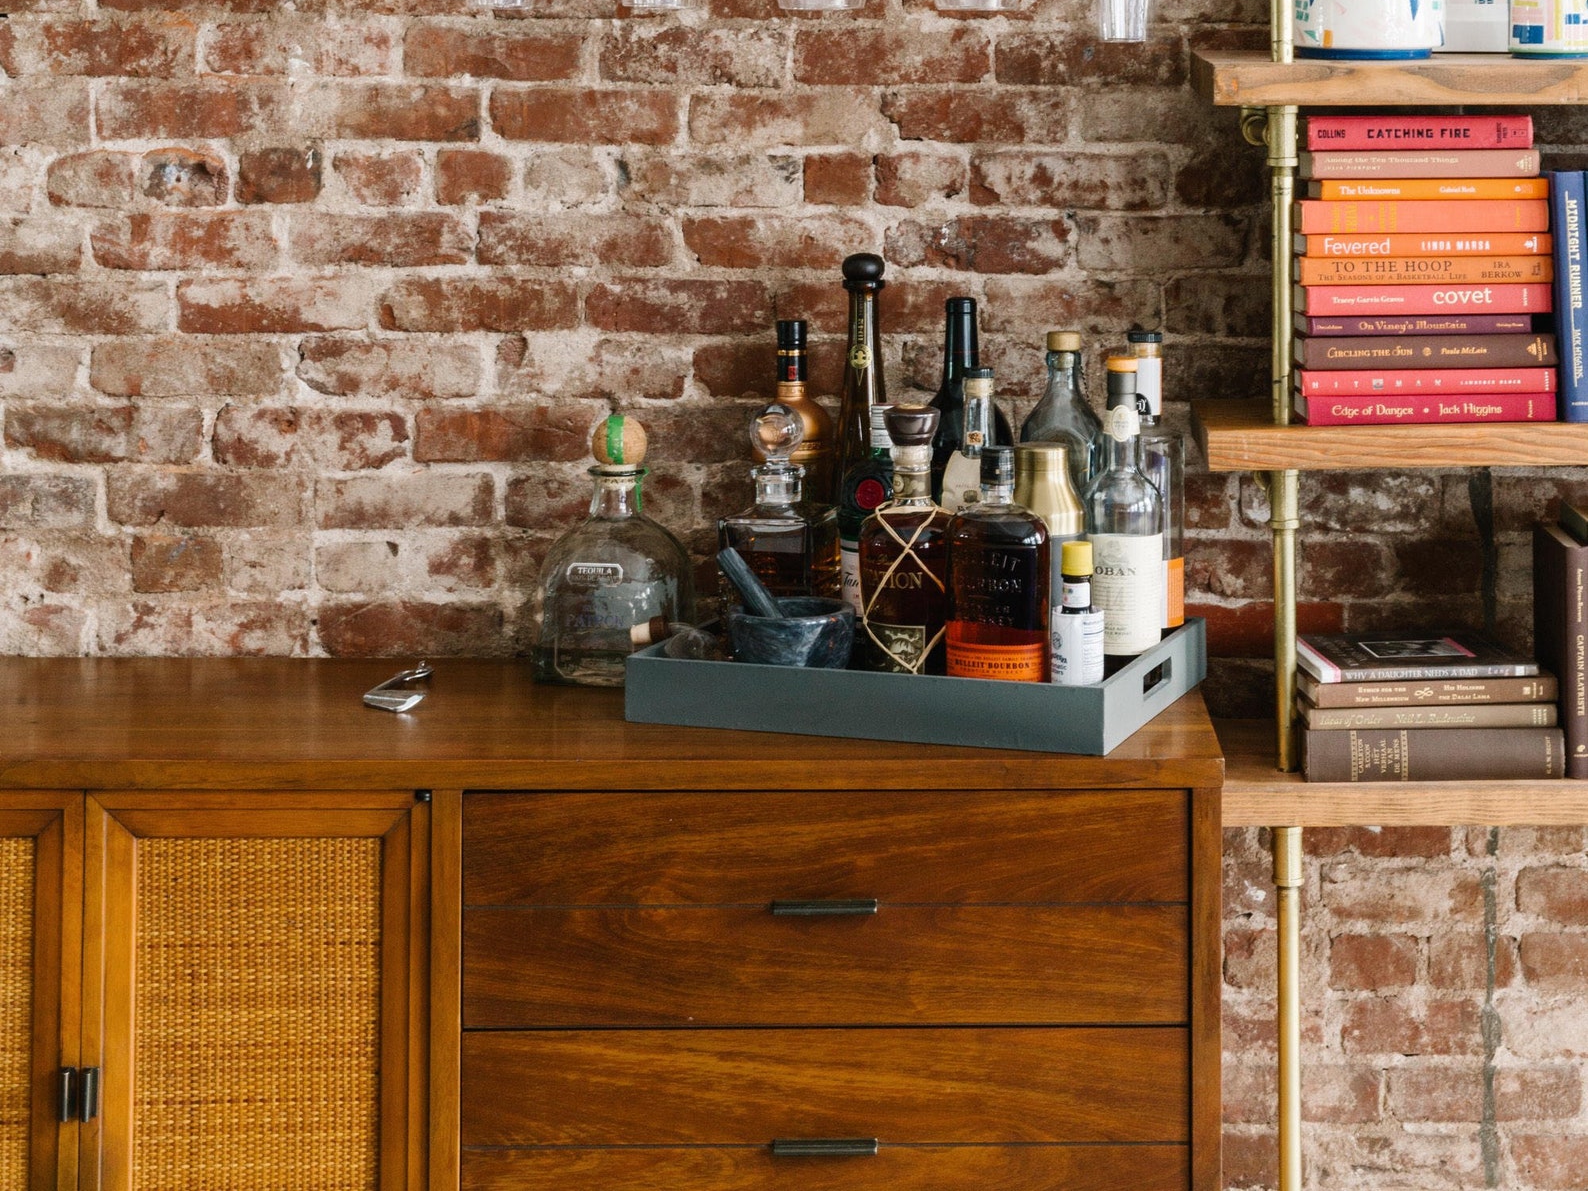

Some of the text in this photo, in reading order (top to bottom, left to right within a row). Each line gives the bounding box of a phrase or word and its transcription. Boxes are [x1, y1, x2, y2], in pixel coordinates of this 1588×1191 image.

[1318, 129, 1346, 139] COLLINS
[1367, 128, 1471, 139] CATCHING FIRE
[1339, 186, 1356, 195] The
[1324, 237, 1390, 255] Fevered
[1568, 199, 1582, 310] MIDNIGHT RUNNER
[1332, 261, 1453, 272] TO THE HOOP
[1493, 261, 1511, 269] IRA
[1481, 270, 1524, 279] BERKOW
[1433, 287, 1493, 304] covet
[1359, 320, 1467, 333] On Viney's Mountain
[1372, 348, 1391, 357] THE
[1392, 345, 1413, 357] SUN
[1332, 403, 1414, 418] Edge of Danger
[1439, 402, 1503, 417] Jack Higgins
[577, 567, 613, 575] TEQUILA
[1094, 565, 1137, 576] OBAN
[988, 661, 1030, 670] BOURBON
[1345, 672, 1368, 680] WHY
[1378, 670, 1423, 679] DAUGHTER
[1459, 668, 1479, 677] DAD
[1576, 635, 1586, 717] CAPTAIN ALATRISTE
